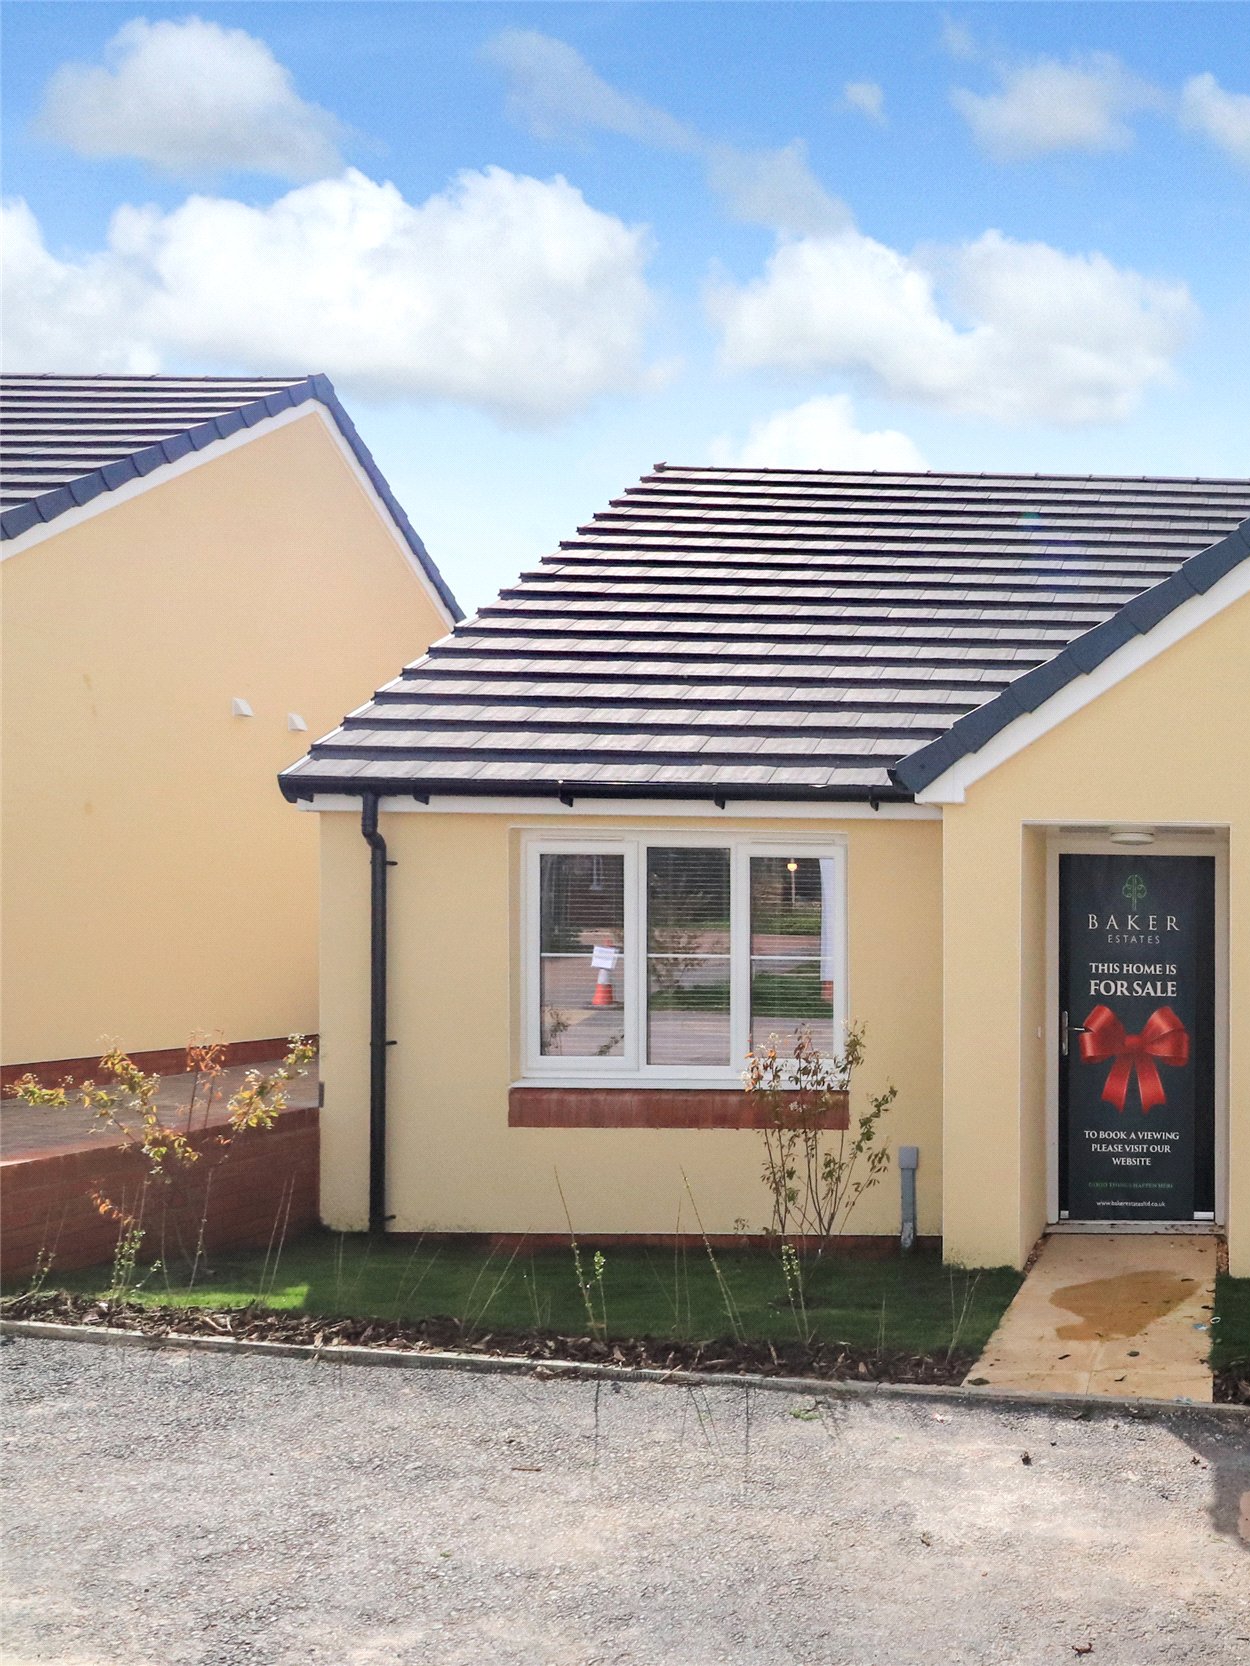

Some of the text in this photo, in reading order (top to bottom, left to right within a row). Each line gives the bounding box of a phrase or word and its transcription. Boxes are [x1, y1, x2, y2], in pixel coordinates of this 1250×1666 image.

[1088, 914, 1180, 931] BAKER
[1108, 934, 1160, 944] ESTATES
[1089, 963, 1177, 975] THIS HOME IS
[1090, 980, 1177, 997] FOR SALE
[1084, 1130, 1180, 1140] TO BOOK A VIEWING
[1091, 1144, 1171, 1153] PLEASE VISIT OUR
[1112, 1157, 1151, 1166] WEBSITE
